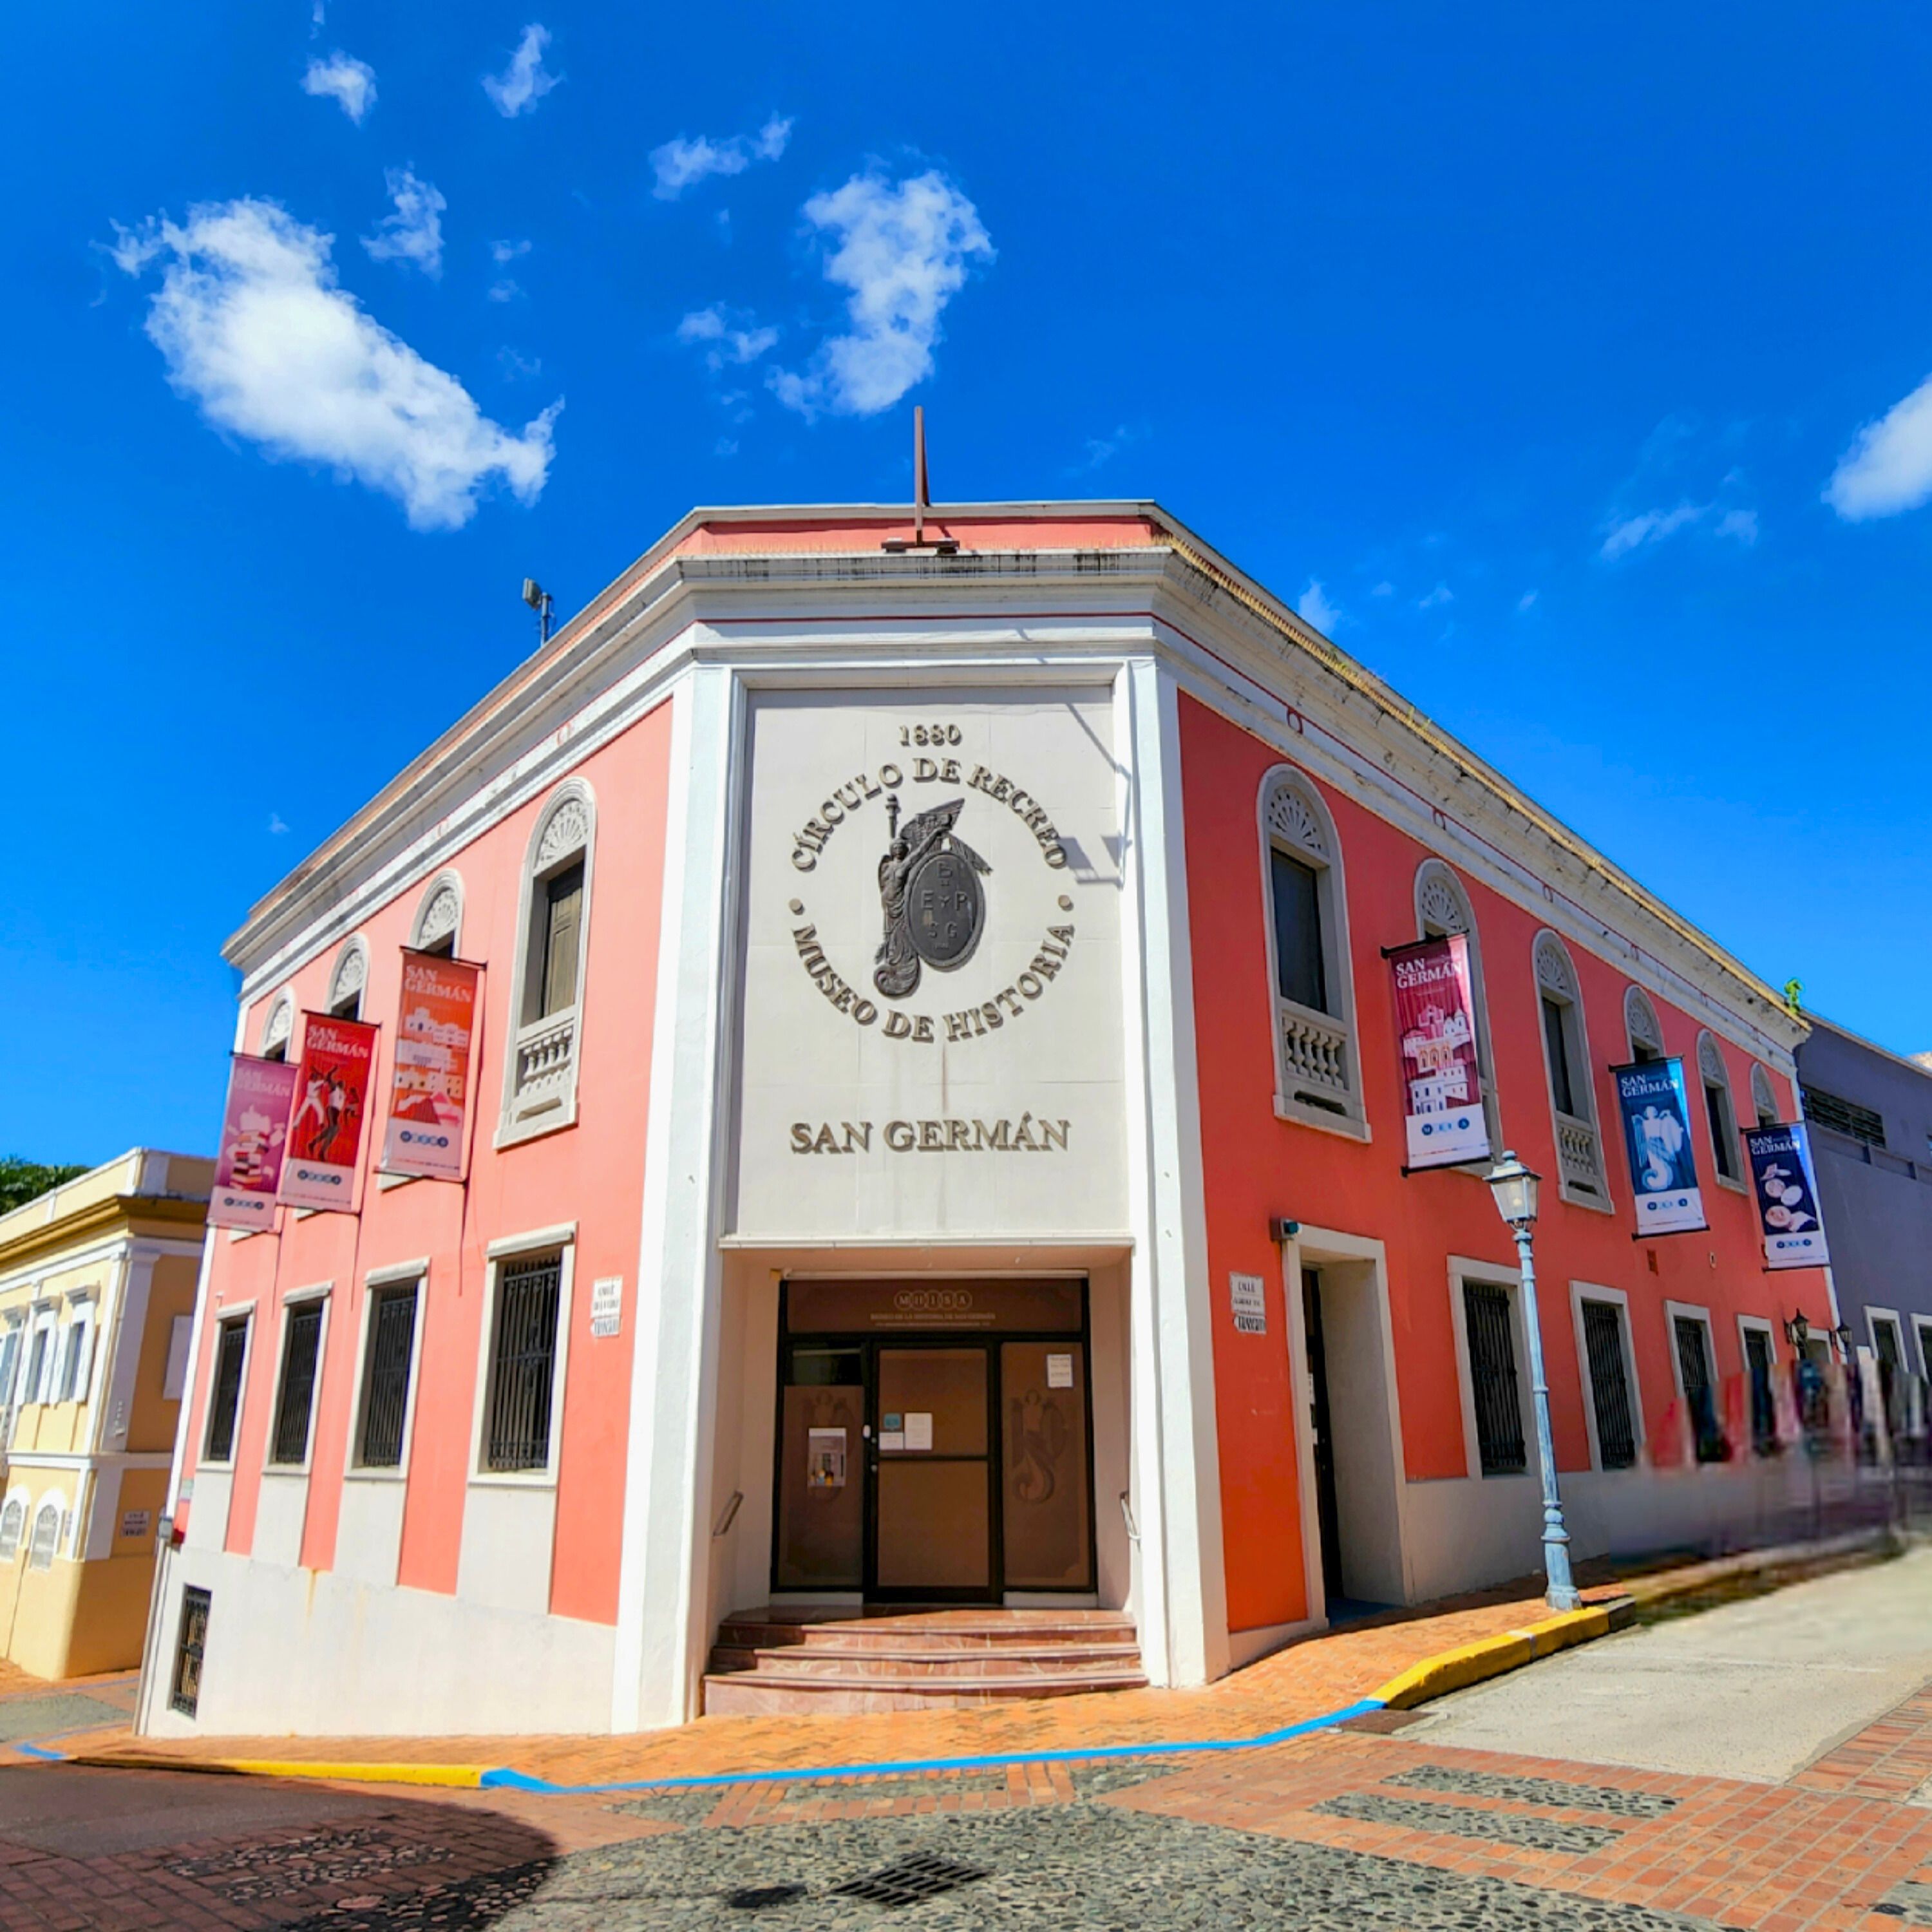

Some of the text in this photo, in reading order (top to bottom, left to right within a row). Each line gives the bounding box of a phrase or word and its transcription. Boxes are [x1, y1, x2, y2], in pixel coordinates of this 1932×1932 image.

[899, 724, 962, 746] 1880
[791, 757, 1068, 872] CÍRCULO DE RECREO
[921, 890, 934, 909] E
[955, 891, 968, 911] P
[406, 965, 438, 981] SAN
[1396, 958, 1425, 976] SAN
[1397, 961, 1462, 989] GERMÁN
[791, 923, 1076, 1043] MUSEO DE HISTORIA
[308, 1024, 338, 1041] SAN
[1621, 1074, 1645, 1088] SAN
[1622, 1077, 1679, 1097] GERMÁN
[790, 1111, 1072, 1154] SAN GERMÁN
[1750, 1135, 1772, 1146] SAN
